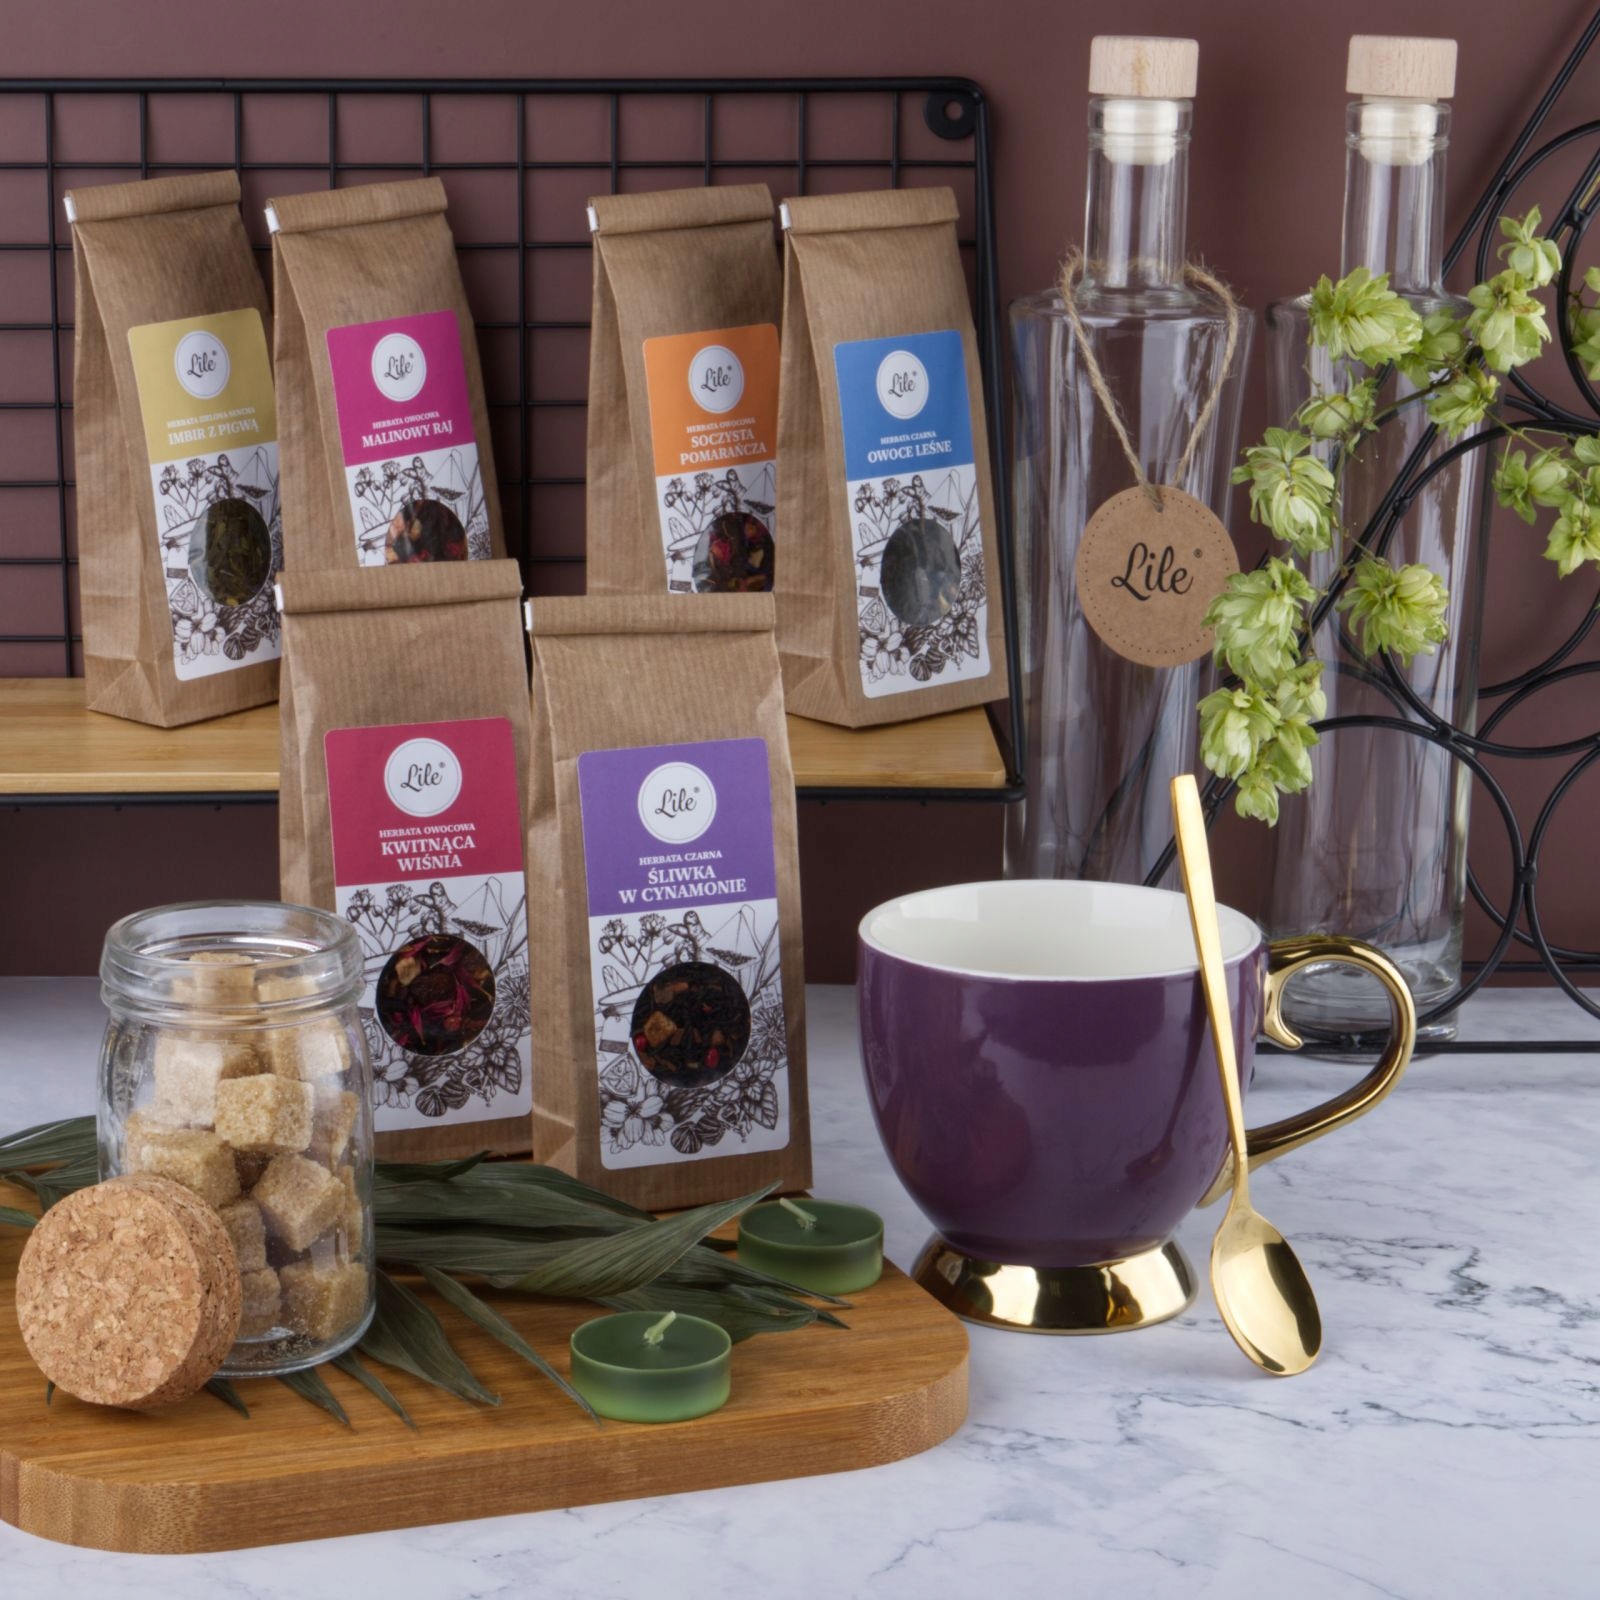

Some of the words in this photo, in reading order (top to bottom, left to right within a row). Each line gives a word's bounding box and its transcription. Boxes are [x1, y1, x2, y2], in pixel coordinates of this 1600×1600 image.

[372, 418, 404, 429] HERBATA
[404, 411, 440, 423] OWOCOWA
[686, 423, 719, 433] HERBATA
[168, 429, 206, 445] IMBIR
[208, 424, 217, 438] Z
[219, 418, 259, 436] PIGWĄ
[361, 424, 430, 448] MALINOWY
[433, 420, 453, 435] RAJ
[691, 428, 755, 448] SOCZYSTA
[880, 434, 911, 445] HERBATA
[911, 431, 937, 441] CZARNA
[680, 441, 767, 465] POMARAŃCZA
[867, 445, 913, 463] OWOCE
[915, 440, 952, 456] LEŚNE
[1111, 542, 1194, 601] Lile
[400, 762, 444, 792] Lile
[654, 787, 699, 819] Lile
[379, 828, 422, 838] HERBATA
[424, 822, 475, 835] OWOCOWA
[381, 835, 476, 855] KWITNĄCA
[397, 854, 463, 872] WIŚNIA
[639, 853, 683, 866] HERBATA
[684, 850, 723, 862] CZARNA
[648, 865, 716, 885] ŚLIWKA
[618, 889, 638, 904] W
[641, 878, 747, 902] CYNAMONIE
